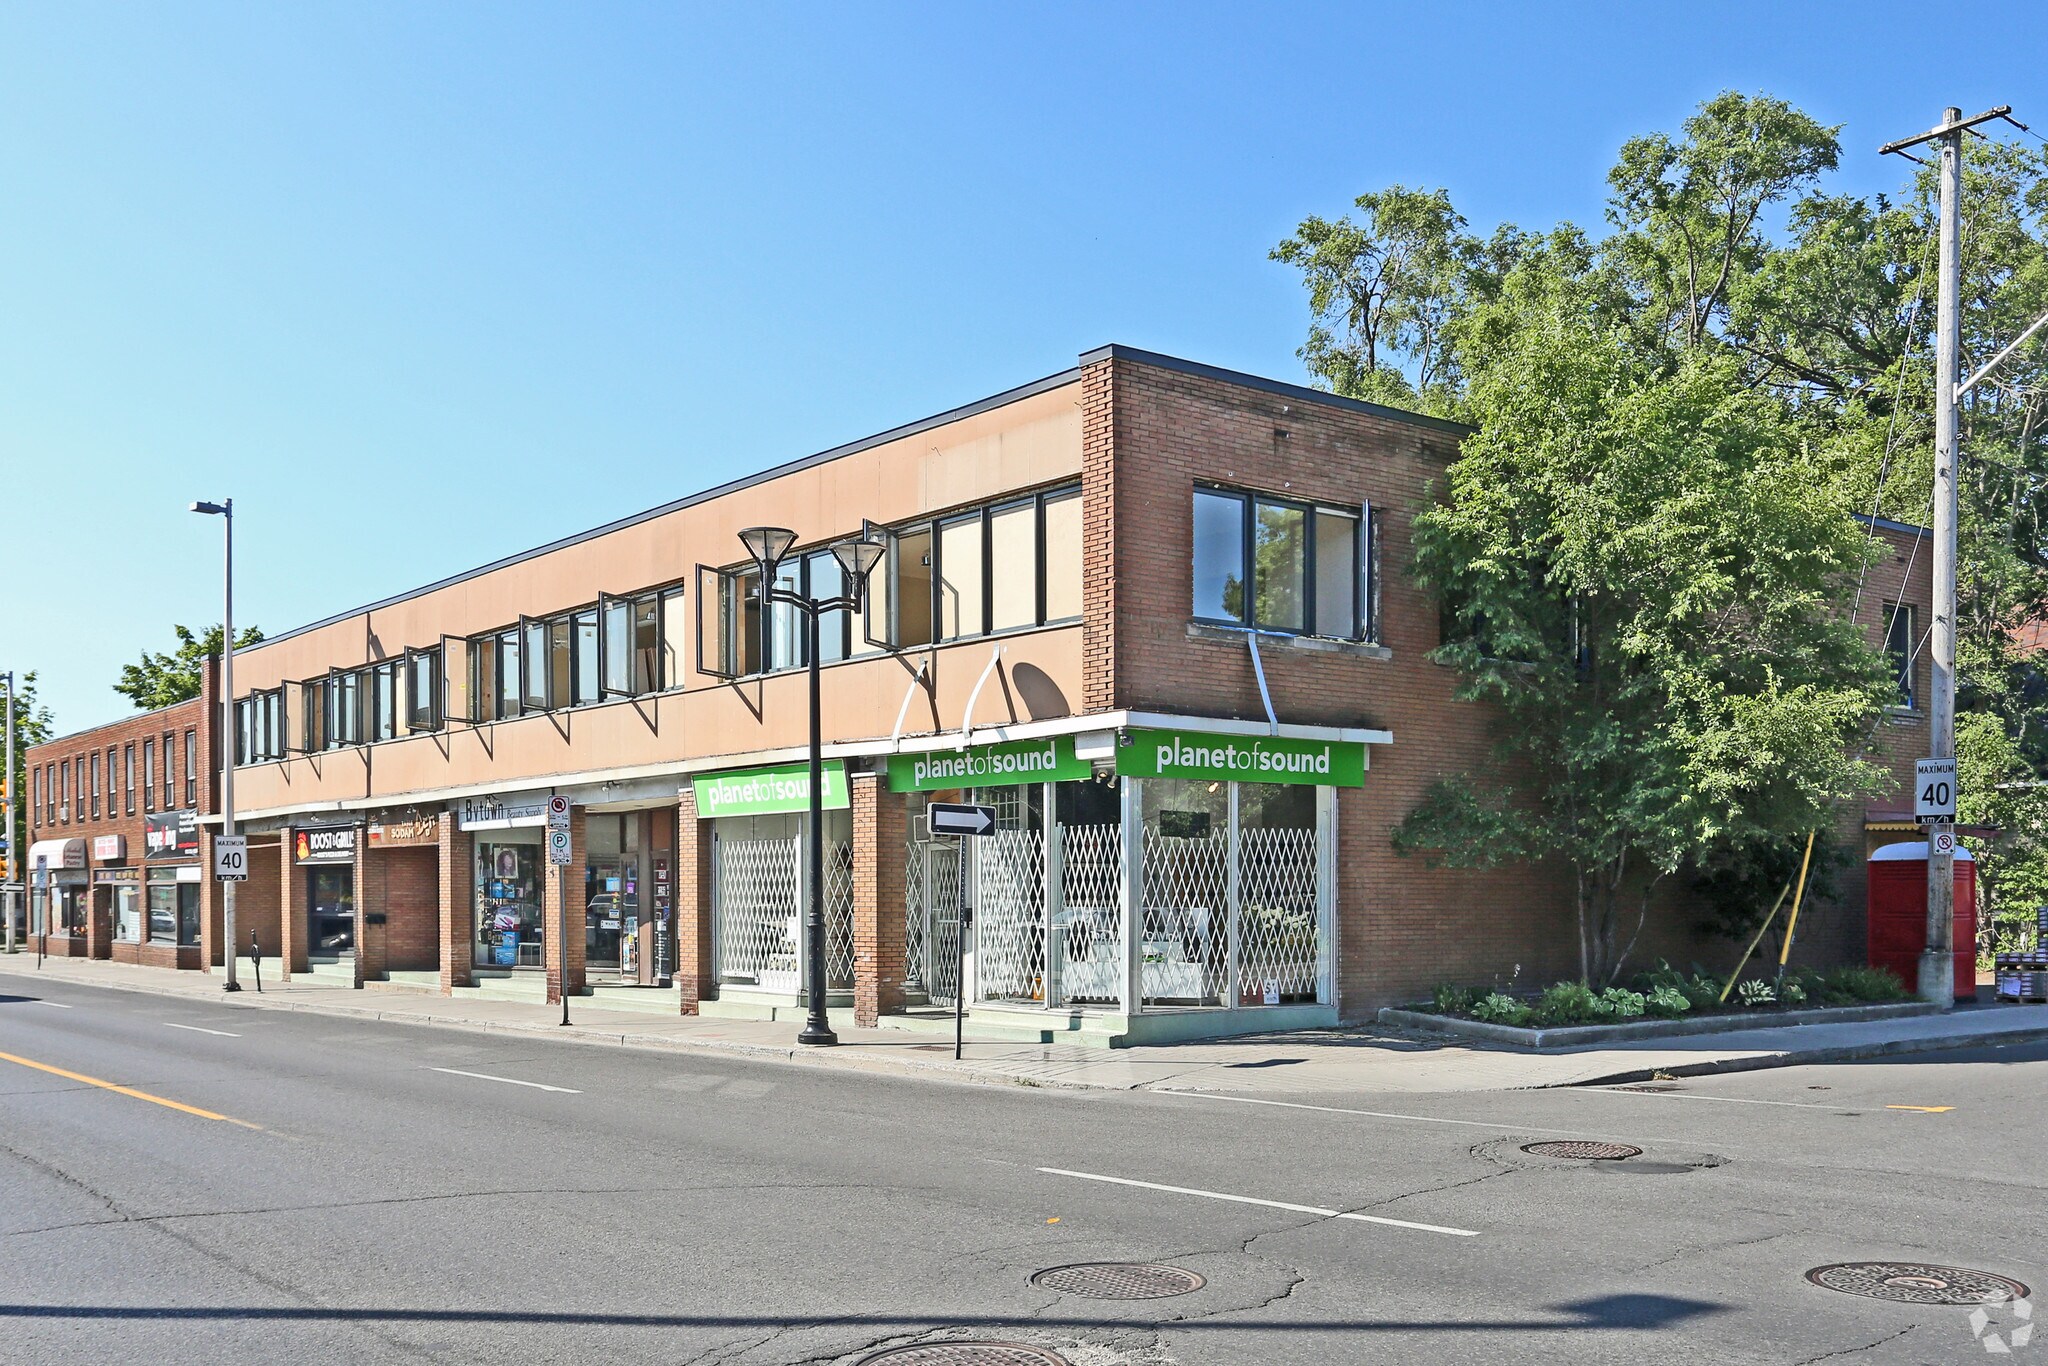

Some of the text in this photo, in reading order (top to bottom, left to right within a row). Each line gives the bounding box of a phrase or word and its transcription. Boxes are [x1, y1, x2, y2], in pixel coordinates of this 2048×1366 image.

[914, 740, 1056, 787] planetofsound
[1156, 736, 1330, 774] planetofsound
[1918, 764, 1954, 774] MAXIMUM
[708, 768, 831, 812] planetofsoud
[1922, 782, 1949, 806] 40
[466, 799, 504, 823] Bytown
[1921, 815, 1949, 823] km/h
[391, 827, 414, 839] SODAM
[221, 852, 242, 869] 40
